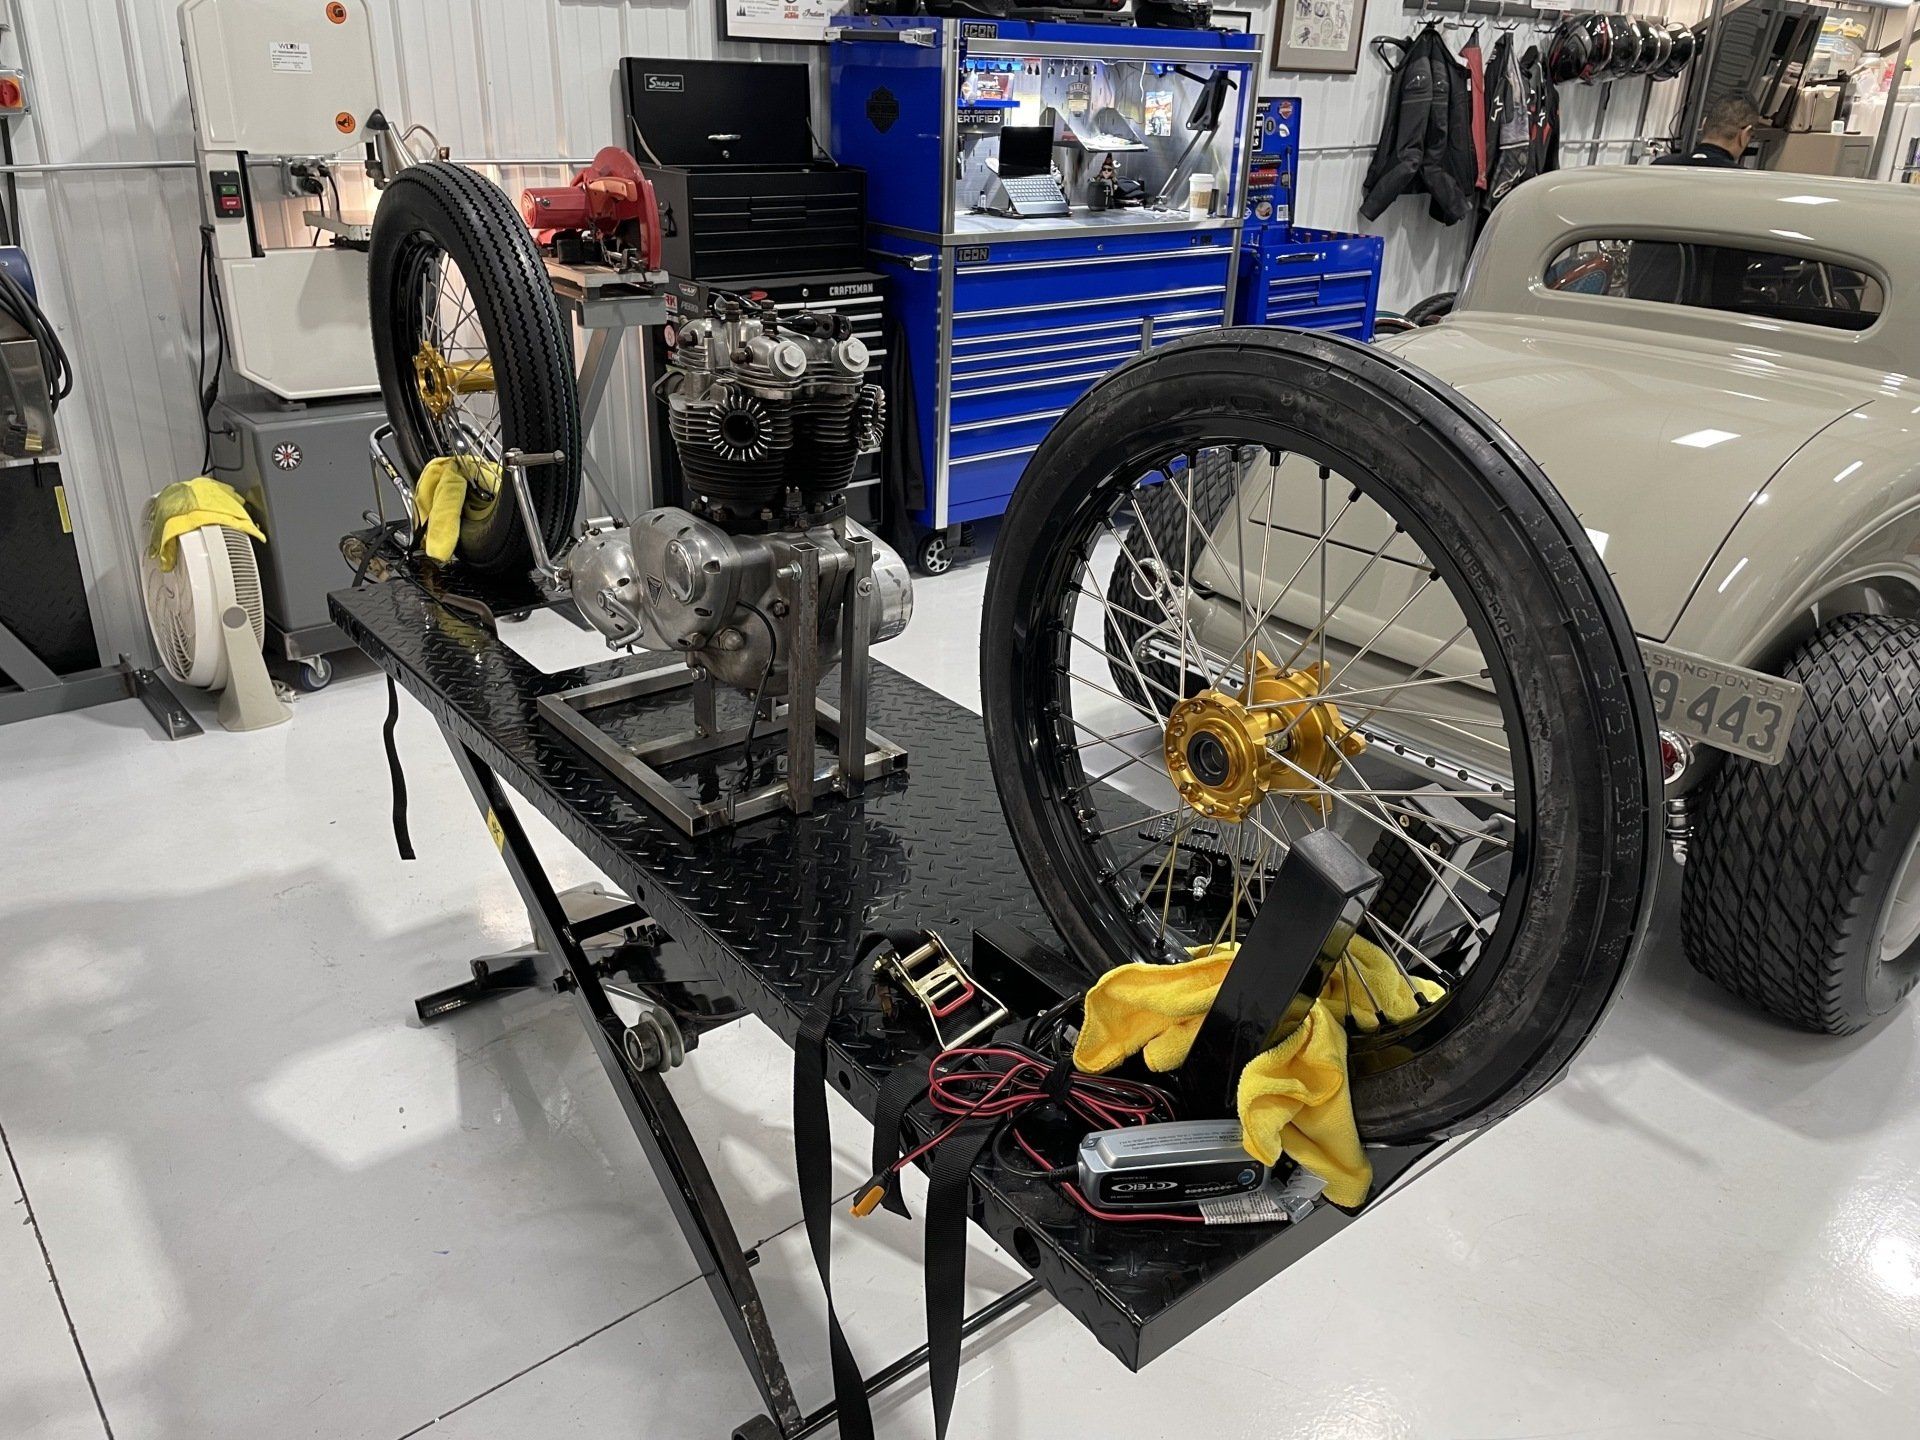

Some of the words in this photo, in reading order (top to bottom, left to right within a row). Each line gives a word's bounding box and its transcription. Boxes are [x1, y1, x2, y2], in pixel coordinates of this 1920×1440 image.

[964, 25, 996, 38] ICON
[957, 114, 1001, 123] ERTIFIED
[958, 249, 988, 261] ICON
[829, 283, 874, 296] CRAFTSMAN
[1647, 667, 1783, 754] 9-443
[1120, 1181, 1172, 1192] CTEK
